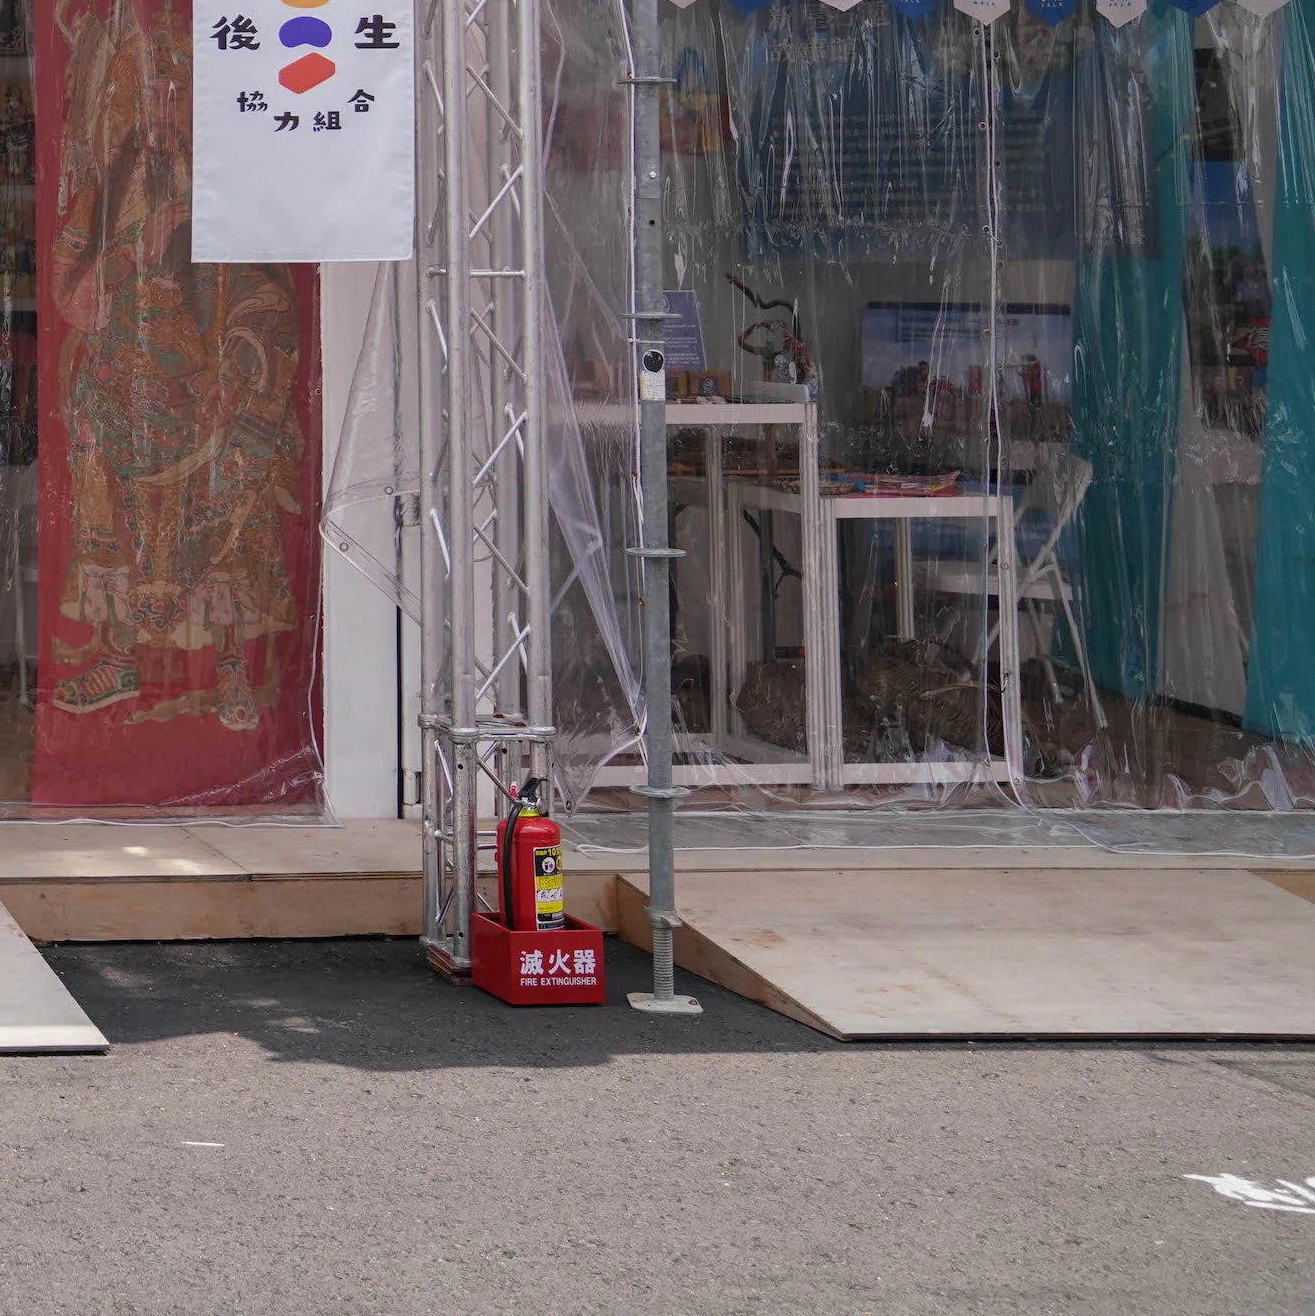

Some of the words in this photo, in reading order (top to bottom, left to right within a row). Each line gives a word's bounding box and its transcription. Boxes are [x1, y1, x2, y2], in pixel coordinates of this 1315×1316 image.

[520, 948, 596, 975] 滅火器
[520, 977, 538, 987] FIRE
[540, 976, 597, 987] EXTINGUISHER
